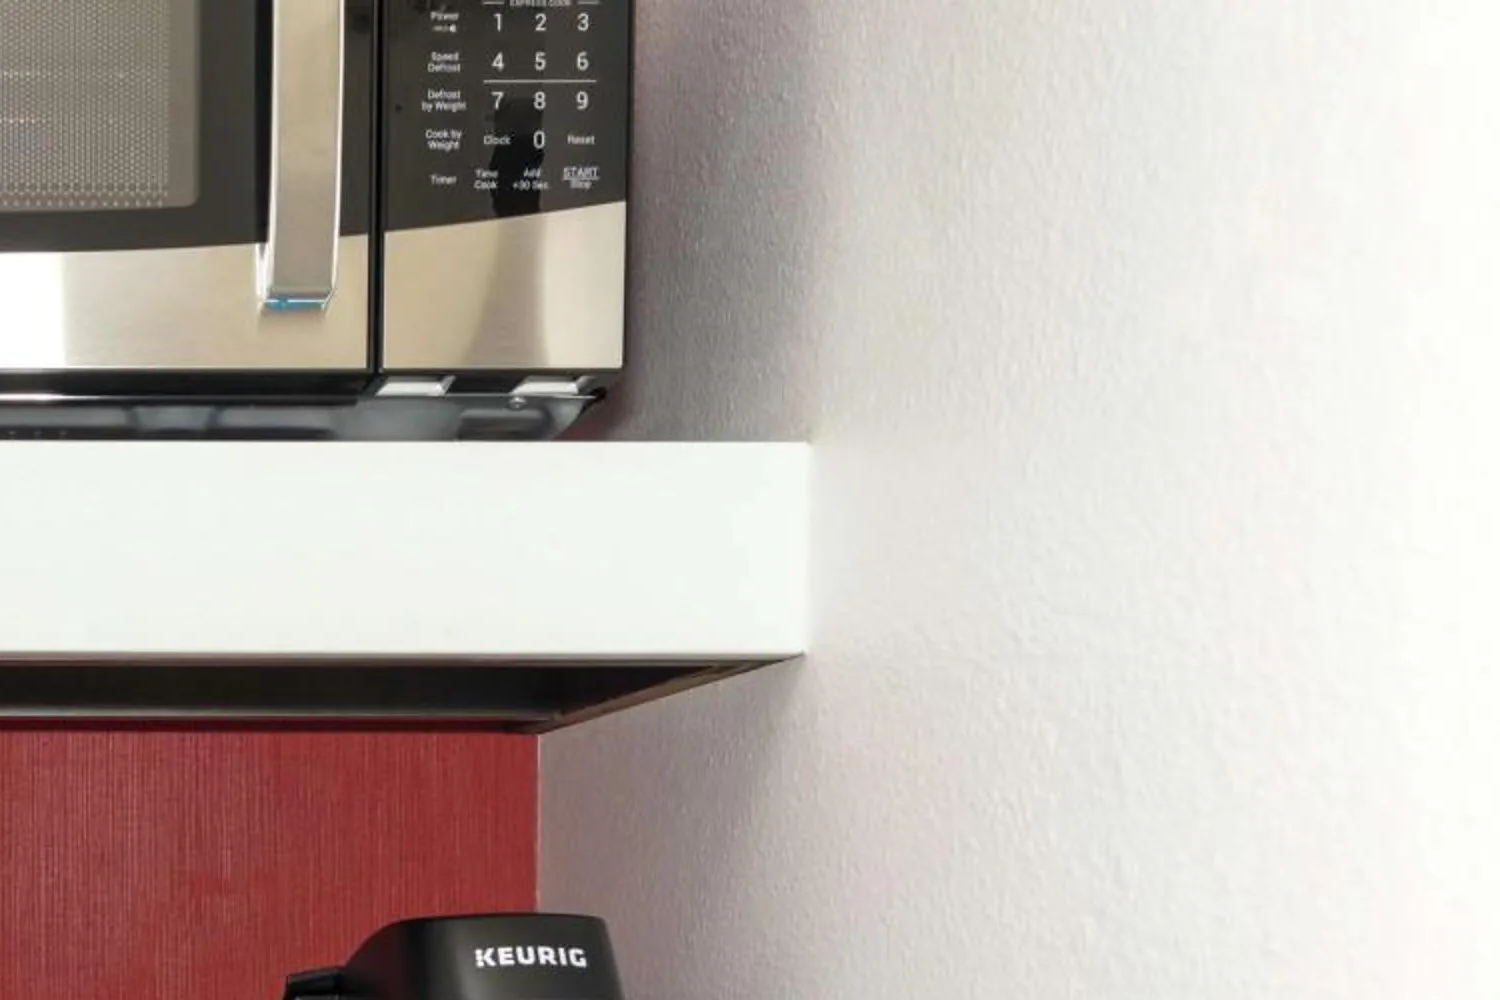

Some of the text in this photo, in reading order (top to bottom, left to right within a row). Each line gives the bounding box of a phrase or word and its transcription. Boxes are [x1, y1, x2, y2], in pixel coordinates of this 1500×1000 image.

[493, 13, 589, 32] 1 2 3
[431, 51, 459, 62] Speed
[491, 51, 589, 71] 4 5 6
[427, 63, 461, 73] Defrost
[427, 89, 461, 100] Defrost
[491, 91, 589, 110] 7 8 9
[421, 101, 467, 112] by Weight
[425, 129, 449, 139] Cook
[533, 130, 545, 149] 0
[567, 134, 596, 145] Reset
[427, 140, 460, 151] Weight
[483, 135, 511, 145] Clock
[430, 174, 457, 185] Timer
[475, 945, 588, 969] KEURIG
